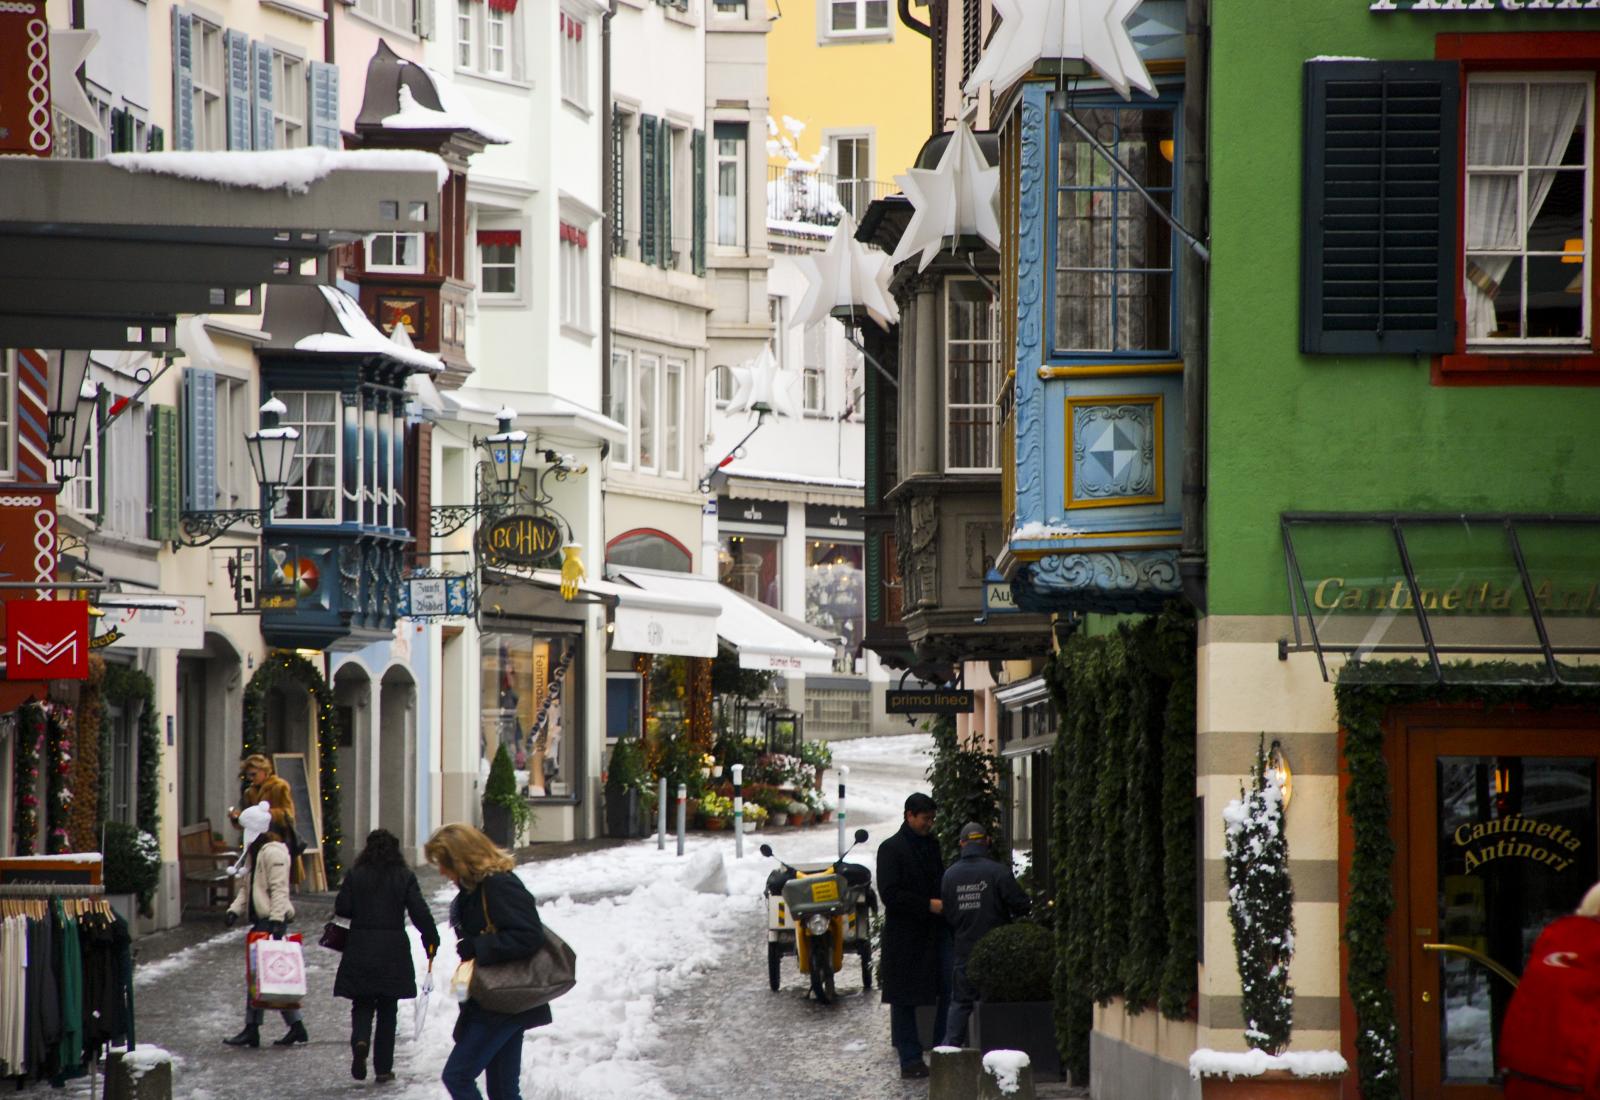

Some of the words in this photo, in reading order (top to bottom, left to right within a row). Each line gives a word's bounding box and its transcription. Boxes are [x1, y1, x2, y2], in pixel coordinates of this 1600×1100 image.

[891, 695, 932, 708] prima
[934, 693, 969, 706] linea
[1454, 813, 1582, 852] Cantinetta
[1464, 837, 1575, 876] Antinori
